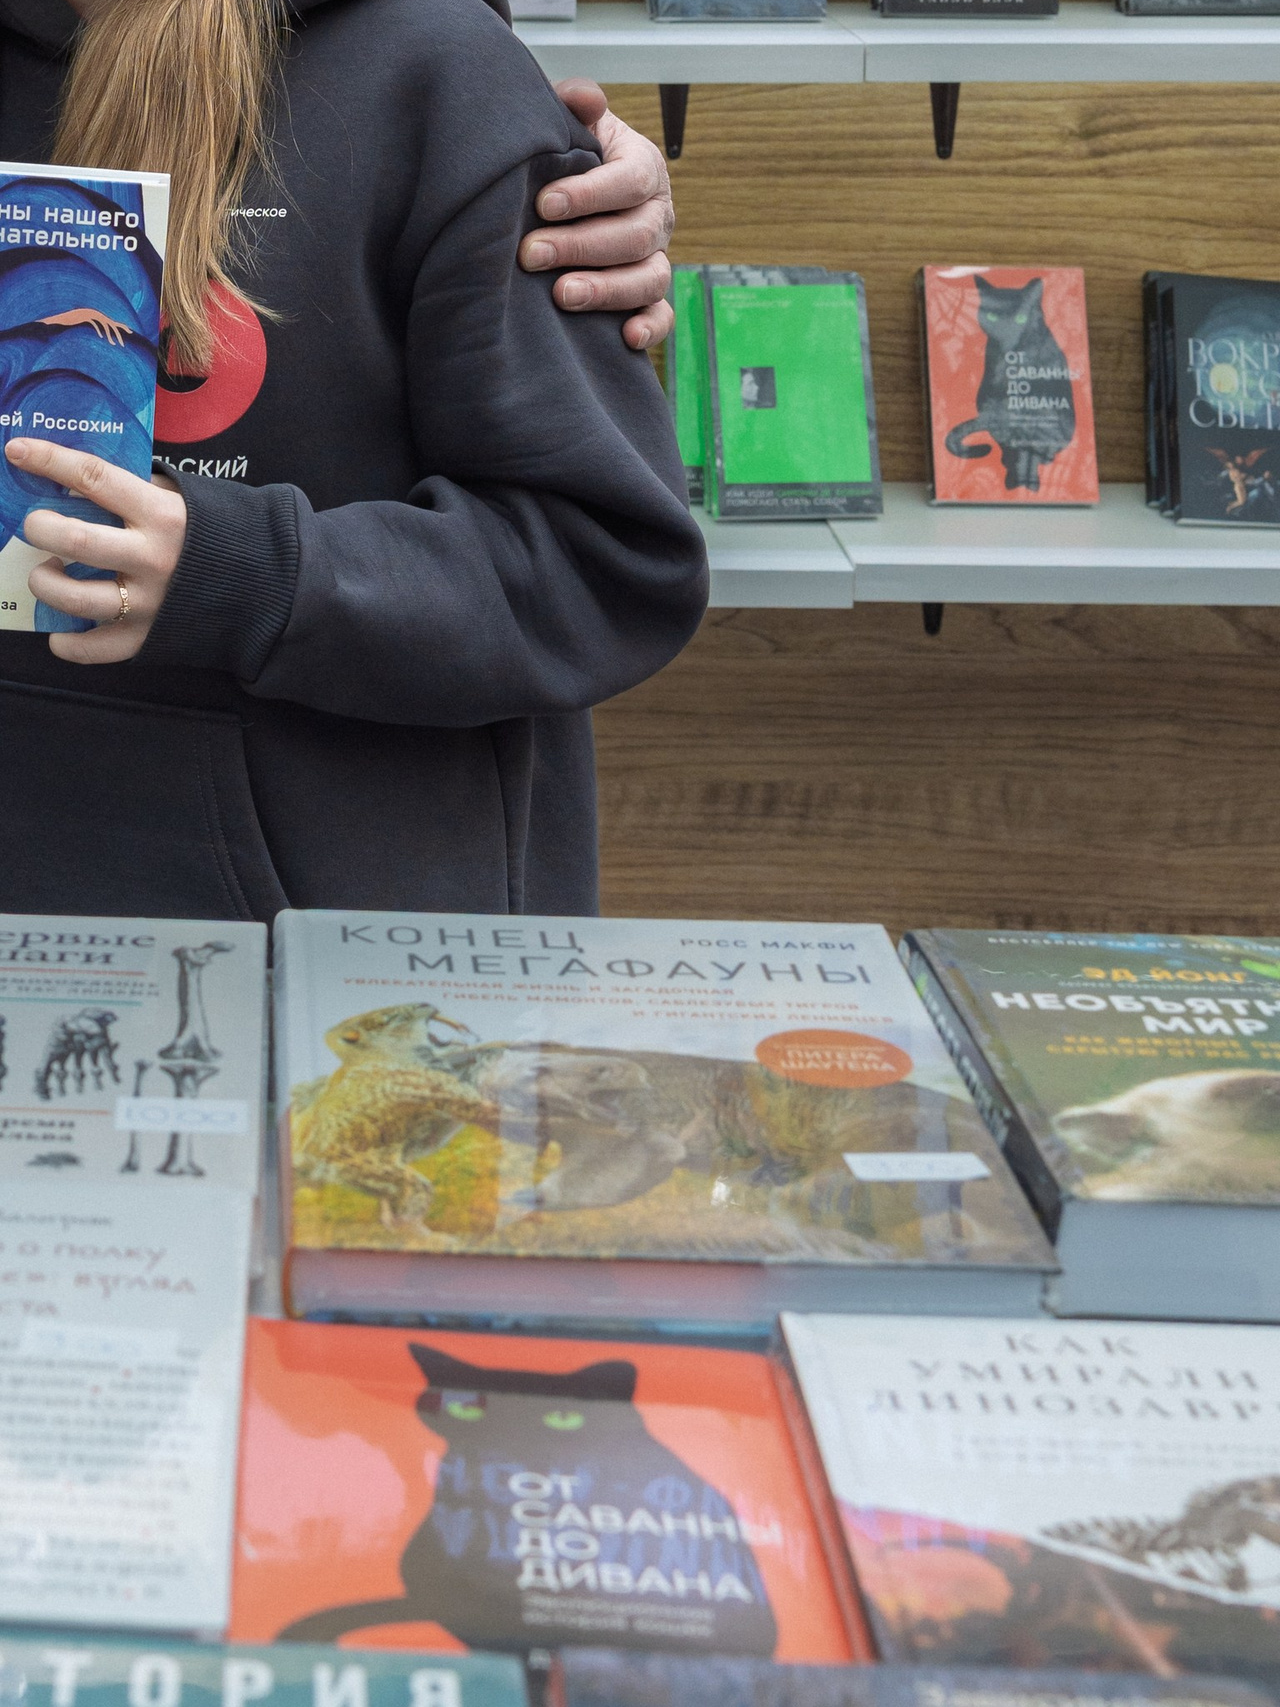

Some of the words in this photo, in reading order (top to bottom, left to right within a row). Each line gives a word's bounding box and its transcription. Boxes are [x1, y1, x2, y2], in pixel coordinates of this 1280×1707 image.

[43, 204, 141, 230] нашего
[1004, 350, 1026, 365] ОТ
[1005, 365, 1081, 381] САВАННЫ
[1006, 380, 1032, 396] ДО
[1007, 395, 1070, 410] ДИВАНА
[1189, 397, 1280, 430] СВЕТ
[32, 411, 125, 436] Россохин
[340, 923, 587, 955] КОНЕЦ
[679, 937, 750, 950] РОСС
[761, 940, 858, 952] МАКФИ
[406, 951, 872, 986] МЕГАФАУНЫ
[990, 991, 1280, 1017] НЕОБЪЯТН
[1141, 1015, 1269, 1036] МИР
[1004, 1332, 1139, 1356] КАК
[907, 1358, 1261, 1391] УМИРАЛИ
[868, 1388, 1280, 1420] ДИНОЗАВР
[507, 1470, 580, 1500] ОТ
[510, 1499, 784, 1546] САВАННЫ
[514, 1527, 601, 1561] ДО
[516, 1560, 754, 1604] ДИВАНА
